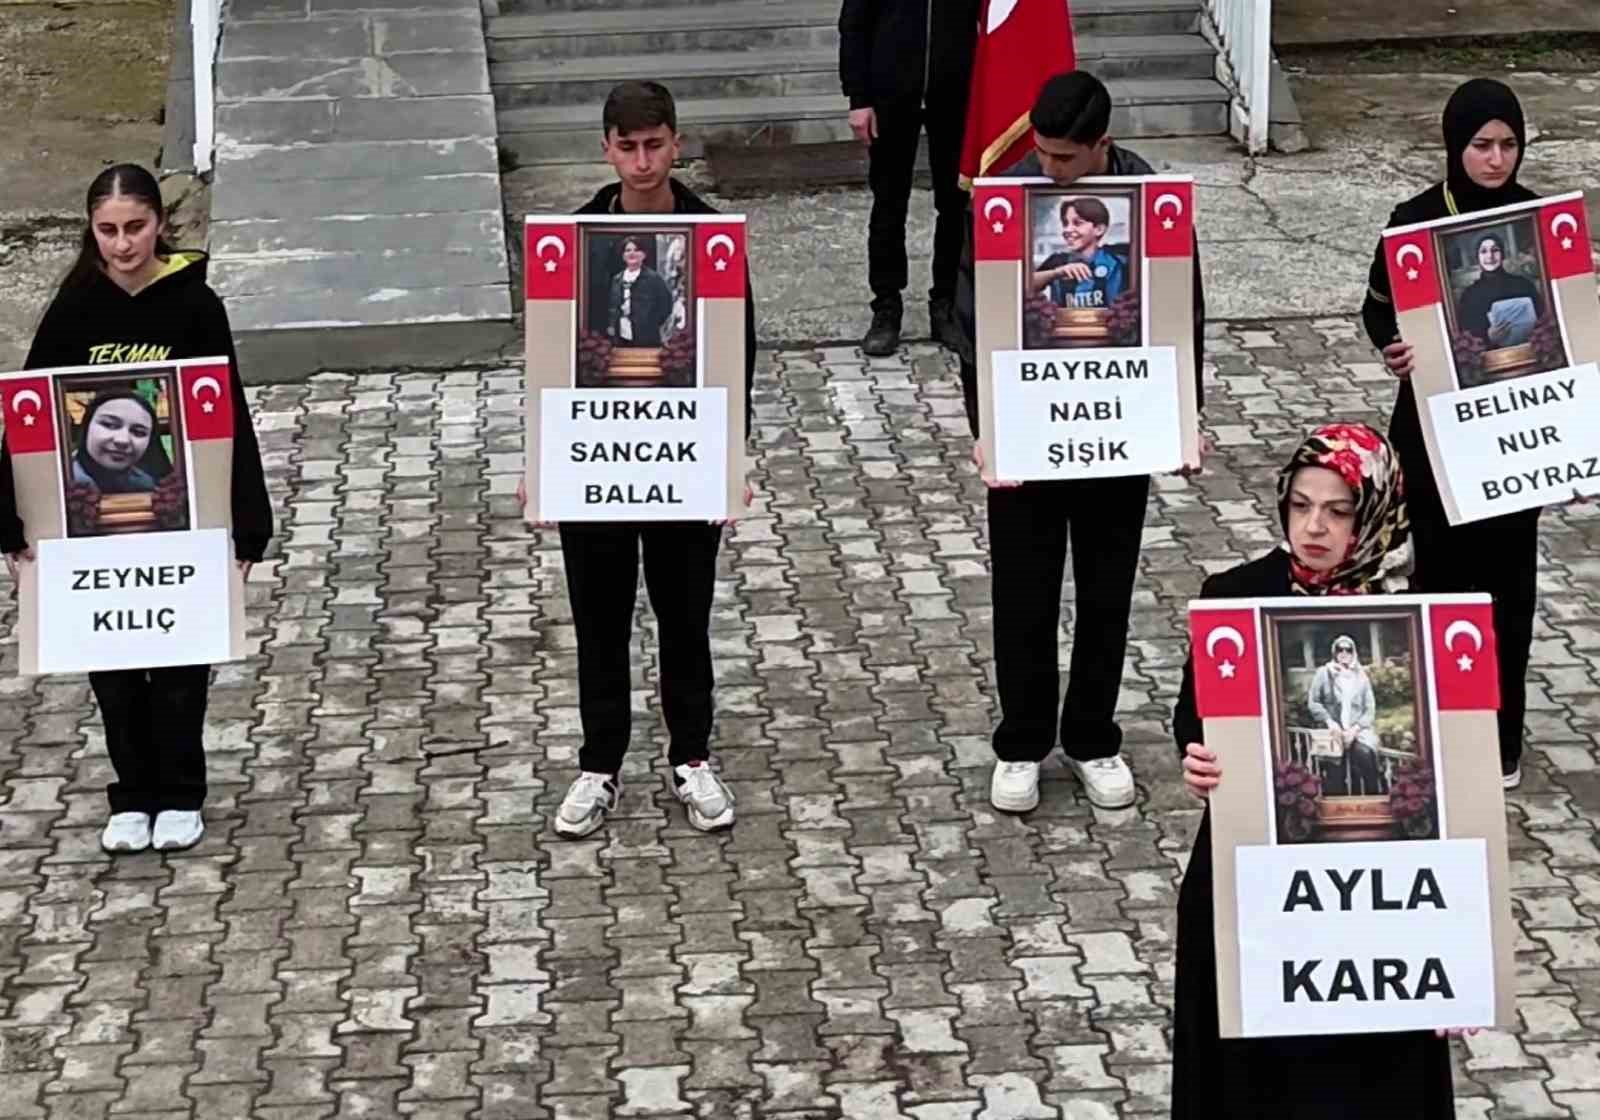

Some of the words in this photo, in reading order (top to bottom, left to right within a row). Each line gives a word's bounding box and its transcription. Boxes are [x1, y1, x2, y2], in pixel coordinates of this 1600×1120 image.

[88, 342, 173, 365] TEKMAN
[1020, 359, 1148, 382] BAYRAM
[571, 400, 697, 420] FURKAN
[1050, 395, 1122, 422] NABİ
[1455, 378, 1576, 423] BELİNAY
[570, 441, 697, 463] SANCAK
[1048, 437, 1129, 469] ŞİŞİK
[1497, 425, 1561, 455] NUR
[1481, 457, 1600, 501] BOYRAZ
[585, 484, 683, 504] BALAL
[71, 565, 195, 591] ZEYNEP
[93, 607, 175, 633] KILIÇ
[1282, 868, 1447, 913] AYLA
[1282, 957, 1455, 1003] KARA
